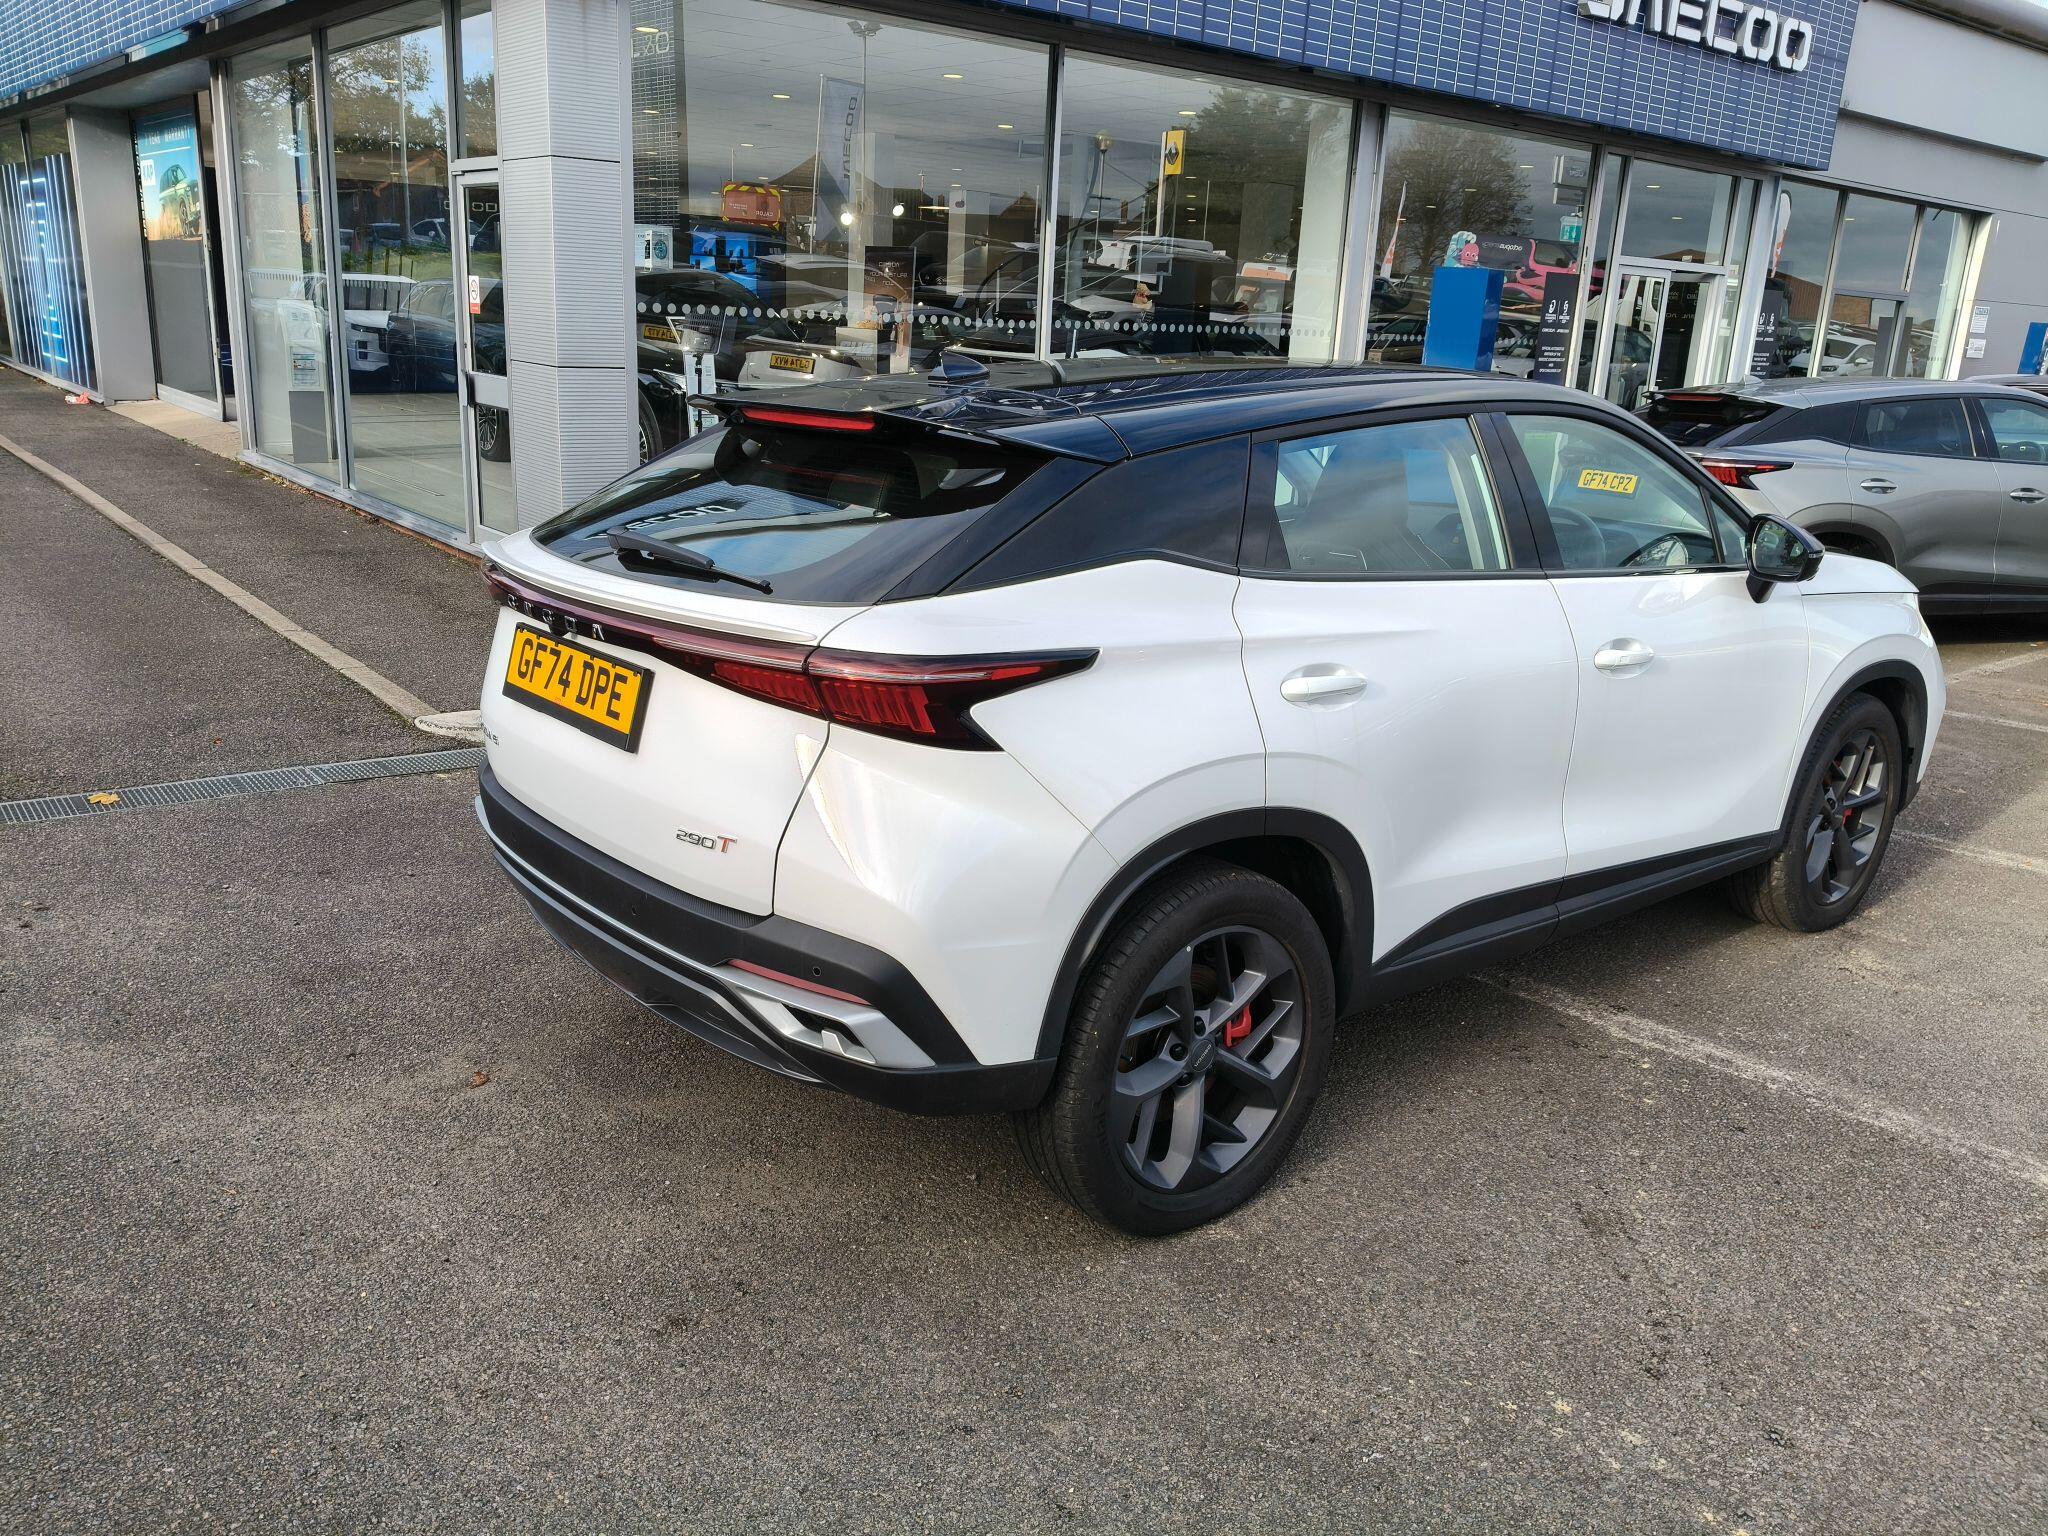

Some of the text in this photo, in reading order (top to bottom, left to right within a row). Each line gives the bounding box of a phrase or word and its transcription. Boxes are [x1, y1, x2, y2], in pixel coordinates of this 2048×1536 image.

[1582, 472, 1633, 491] GF74 CPZ
[517, 637, 629, 721] GF74 DPE
[676, 828, 738, 854] 290T
